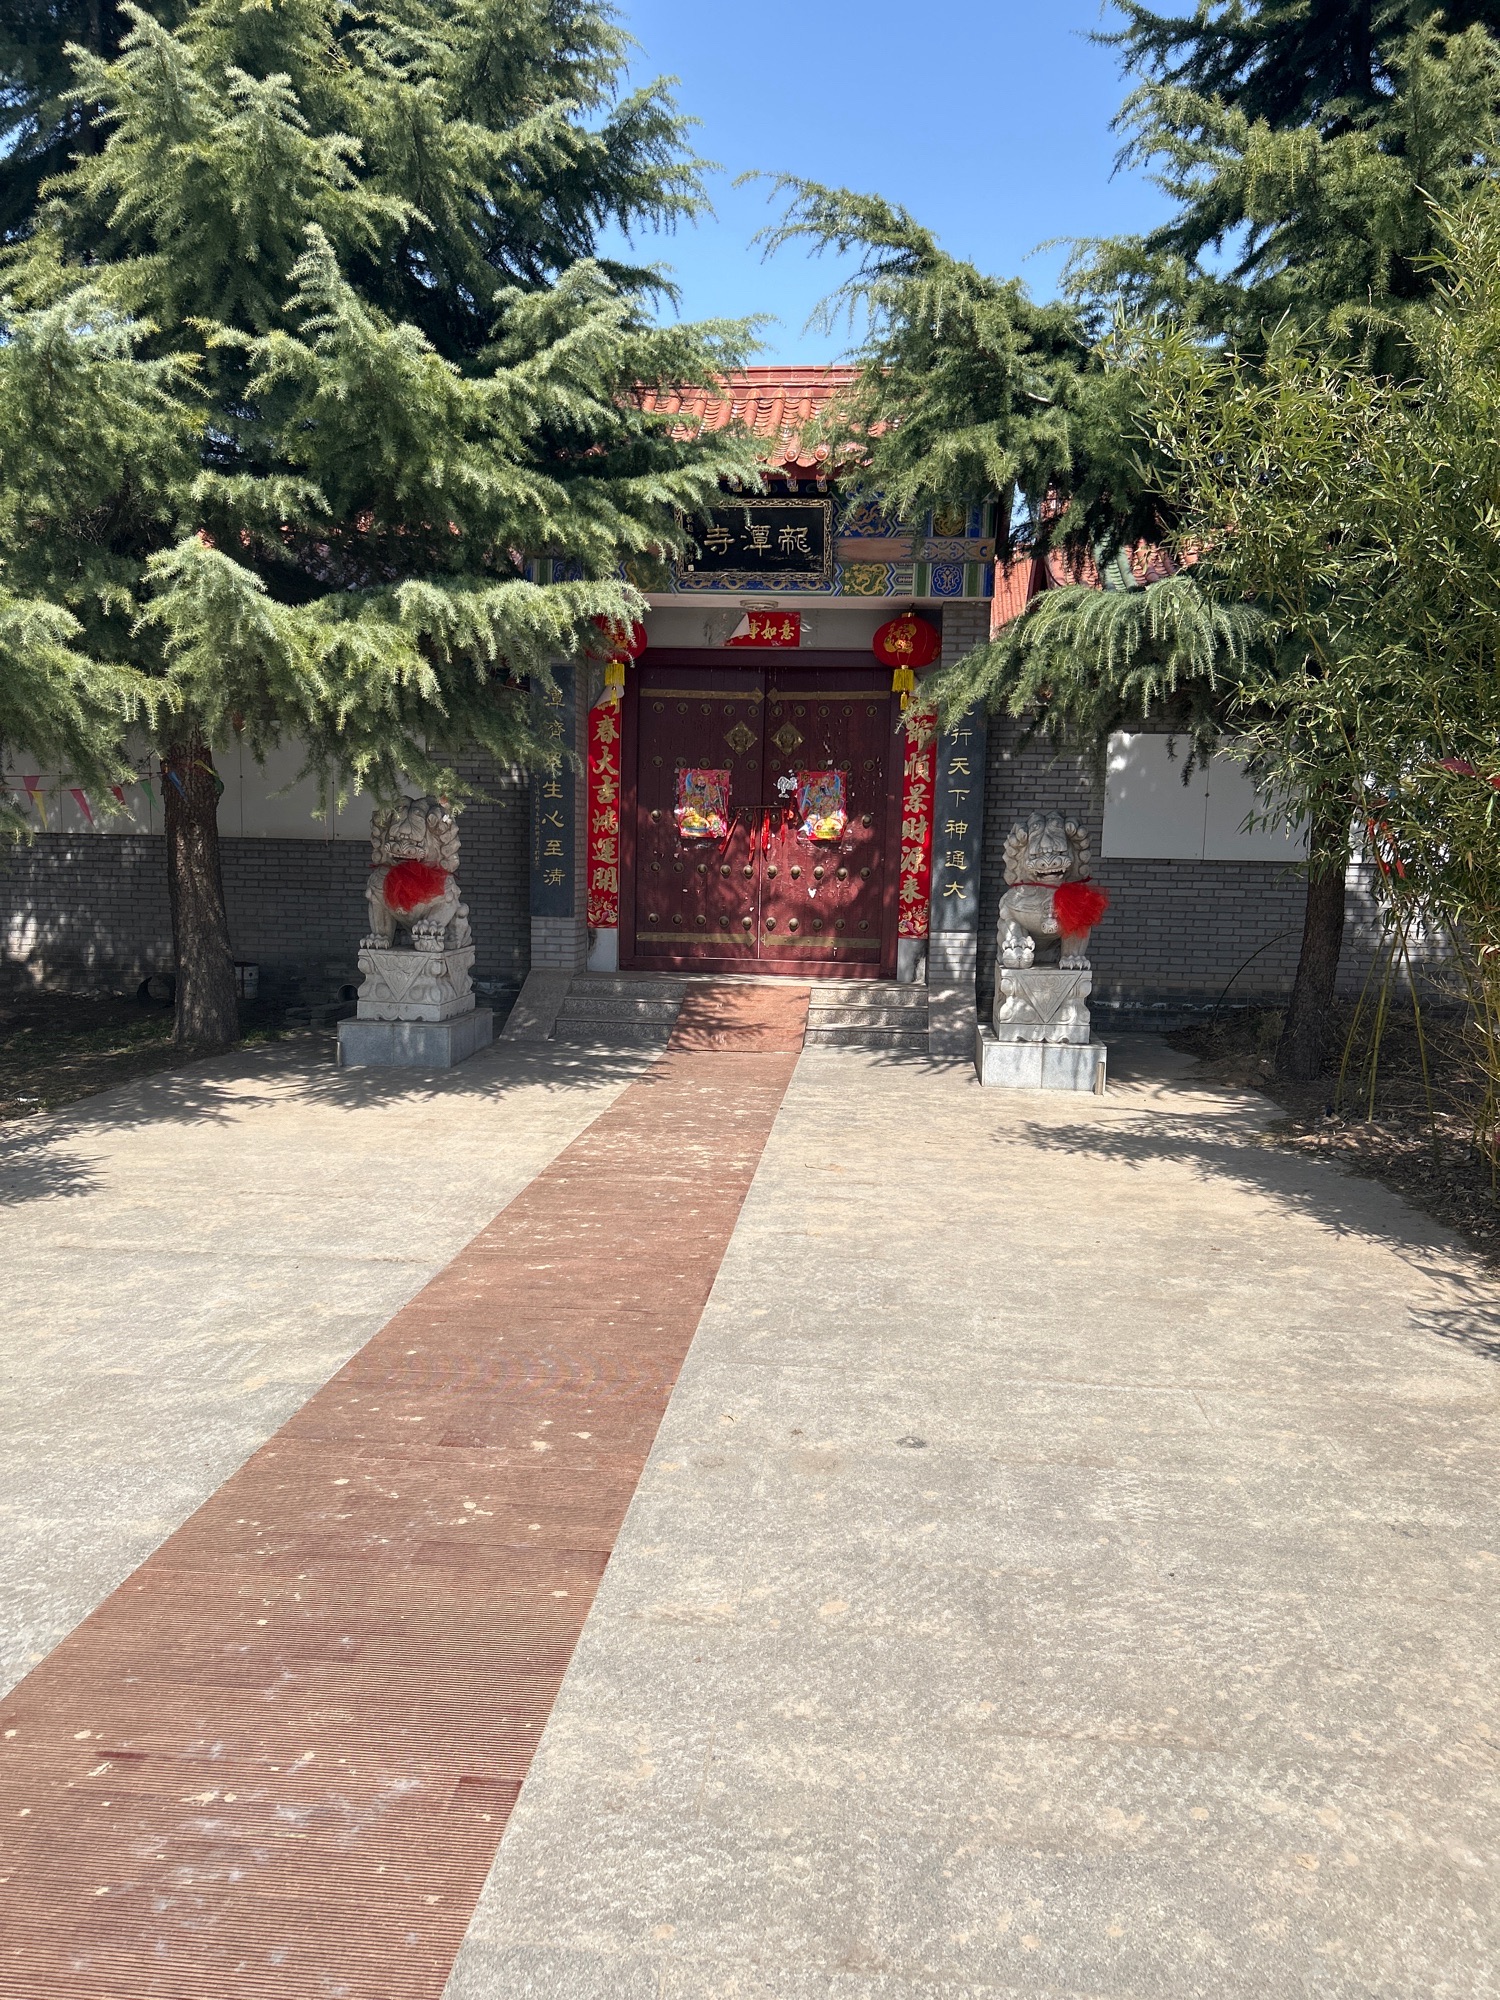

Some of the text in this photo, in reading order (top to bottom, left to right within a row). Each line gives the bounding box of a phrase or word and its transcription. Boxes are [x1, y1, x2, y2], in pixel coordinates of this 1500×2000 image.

[738, 618, 796, 640] 事如意
[592, 699, 620, 893] 春大吉鴻運開
[943, 711, 975, 899] 行天下神通大
